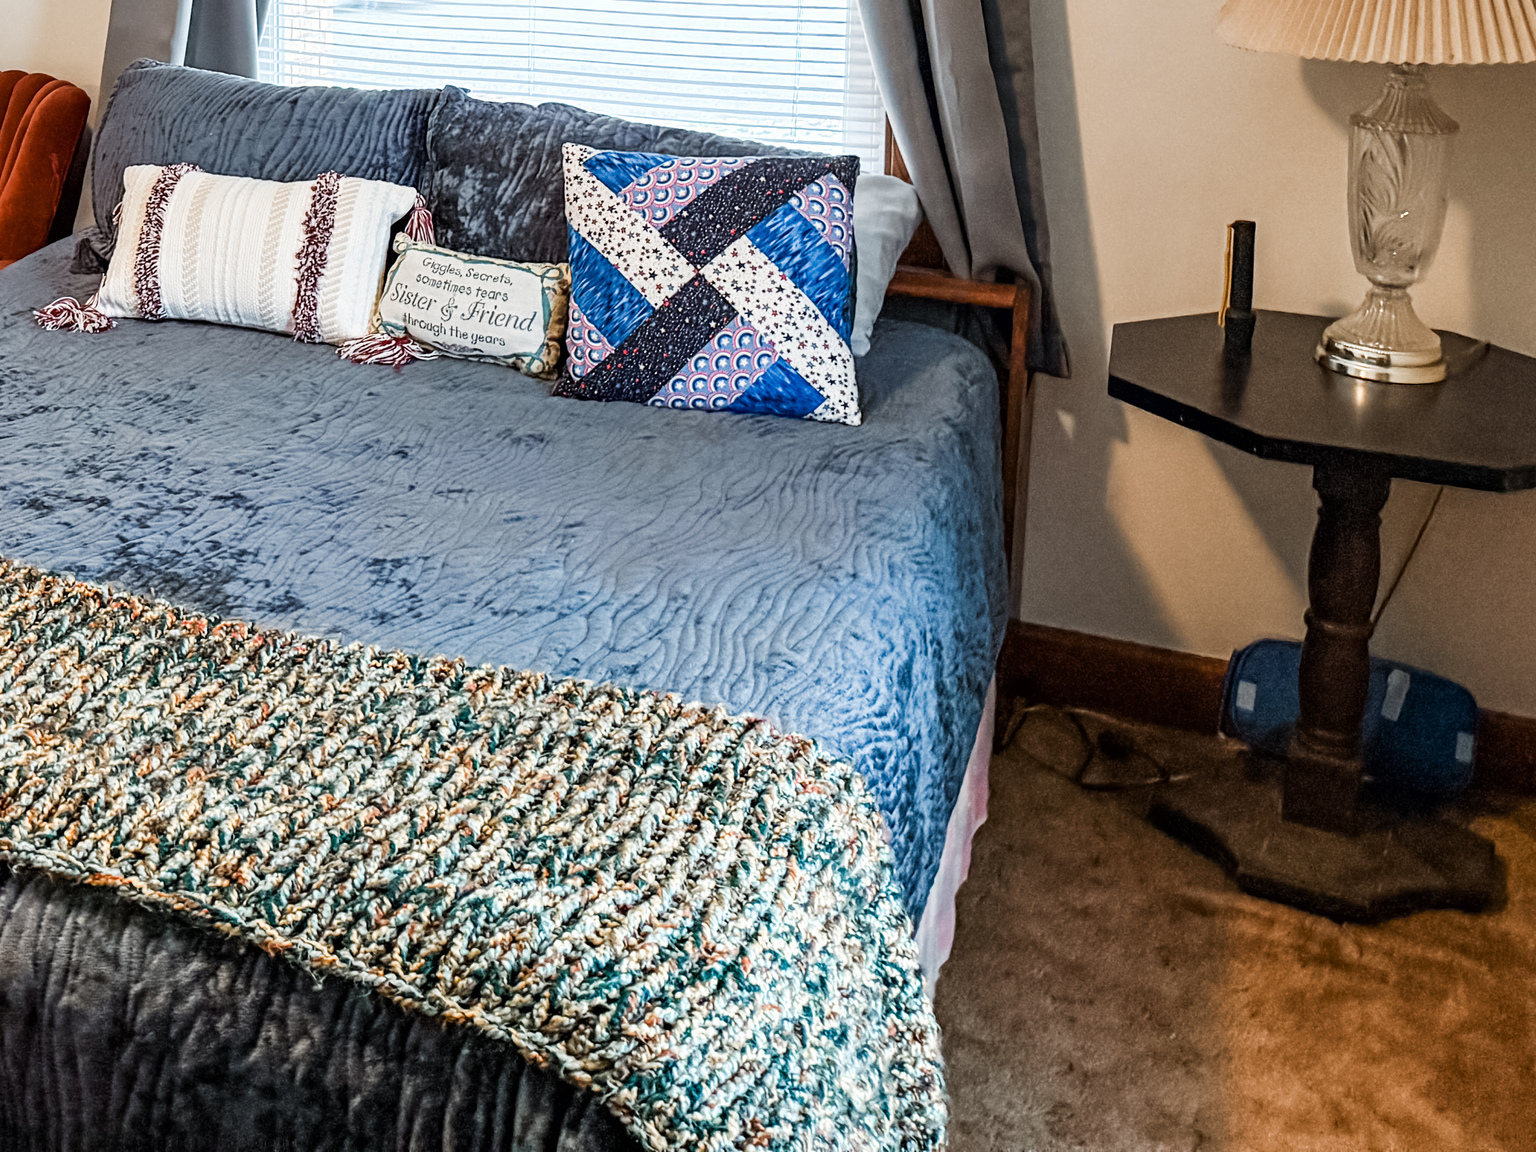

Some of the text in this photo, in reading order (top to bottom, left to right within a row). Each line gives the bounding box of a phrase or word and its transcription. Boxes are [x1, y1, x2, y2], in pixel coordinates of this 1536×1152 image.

[422, 257, 513, 286] Giggles, Secrets,
[416, 274, 509, 302] sometimes tears
[390, 282, 538, 332] Sister & Friend
[403, 312, 506, 346] through the years
